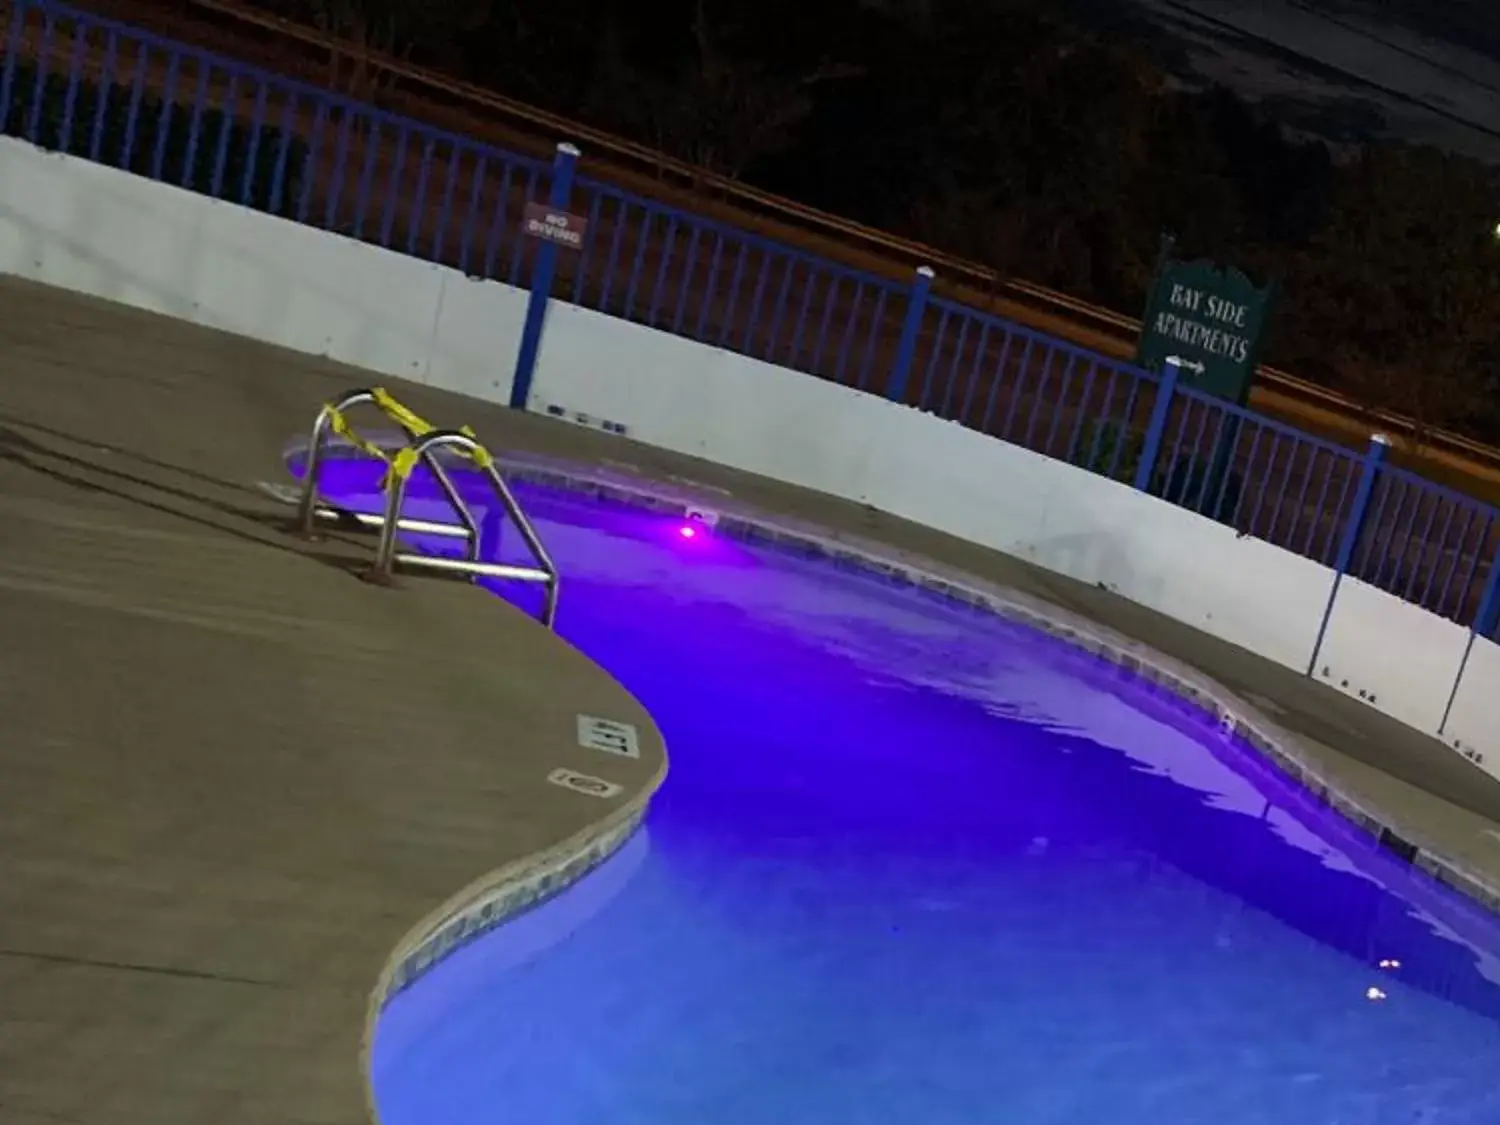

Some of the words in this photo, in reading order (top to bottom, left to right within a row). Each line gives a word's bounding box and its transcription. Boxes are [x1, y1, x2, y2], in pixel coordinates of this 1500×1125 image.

[528, 219, 580, 243] DIVING
[545, 213, 569, 228] NO
[1170, 283, 1202, 311] BAY
[1204, 295, 1249, 328] SIDE
[1154, 312, 1248, 364] APARTMENTS
